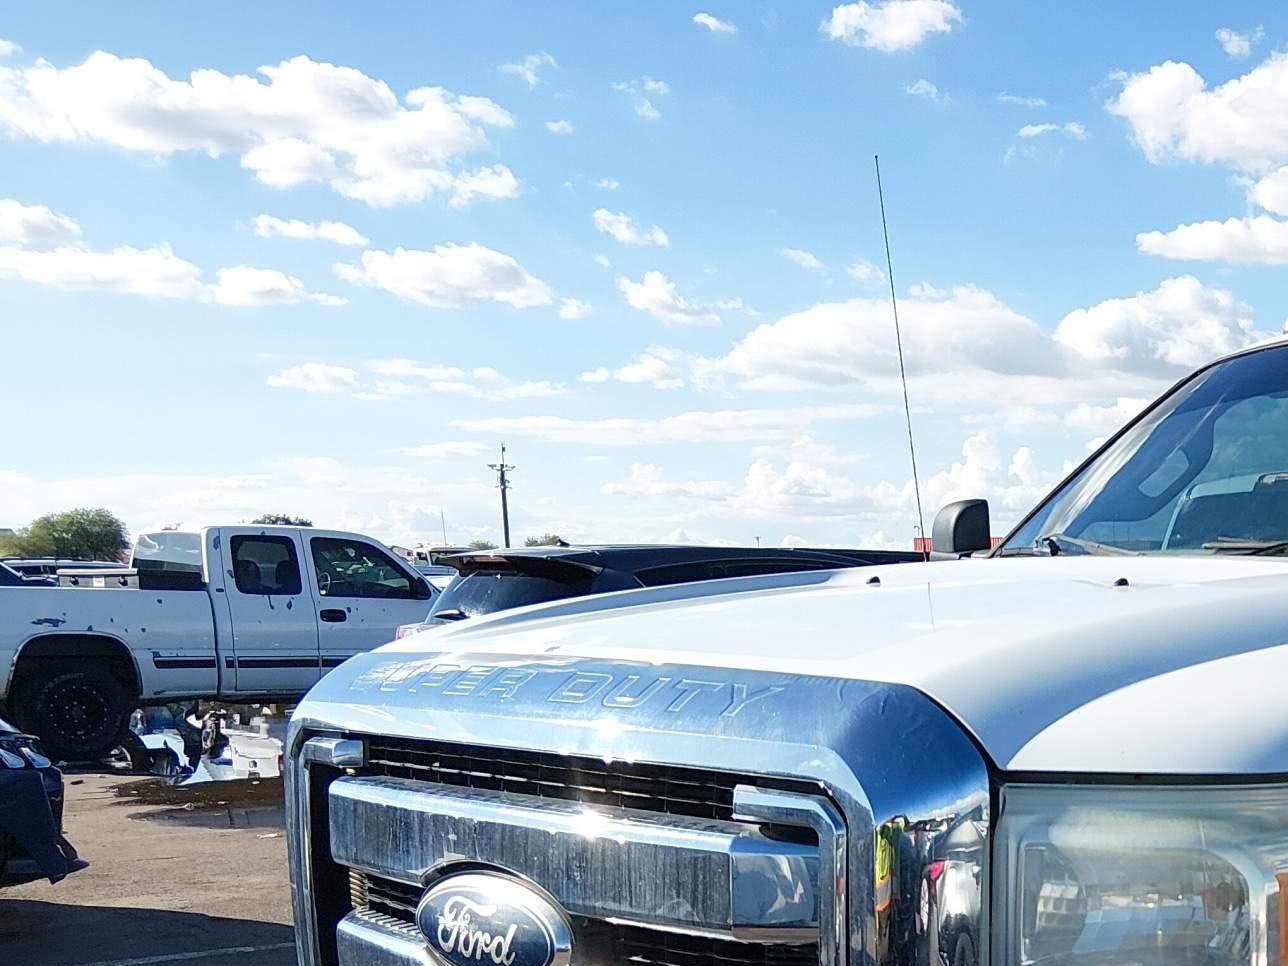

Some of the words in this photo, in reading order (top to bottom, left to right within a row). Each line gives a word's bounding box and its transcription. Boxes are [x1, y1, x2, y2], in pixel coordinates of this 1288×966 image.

[350, 662, 538, 698] SUPER
[547, 671, 785, 717] DUTY
[437, 895, 518, 966] Ford
